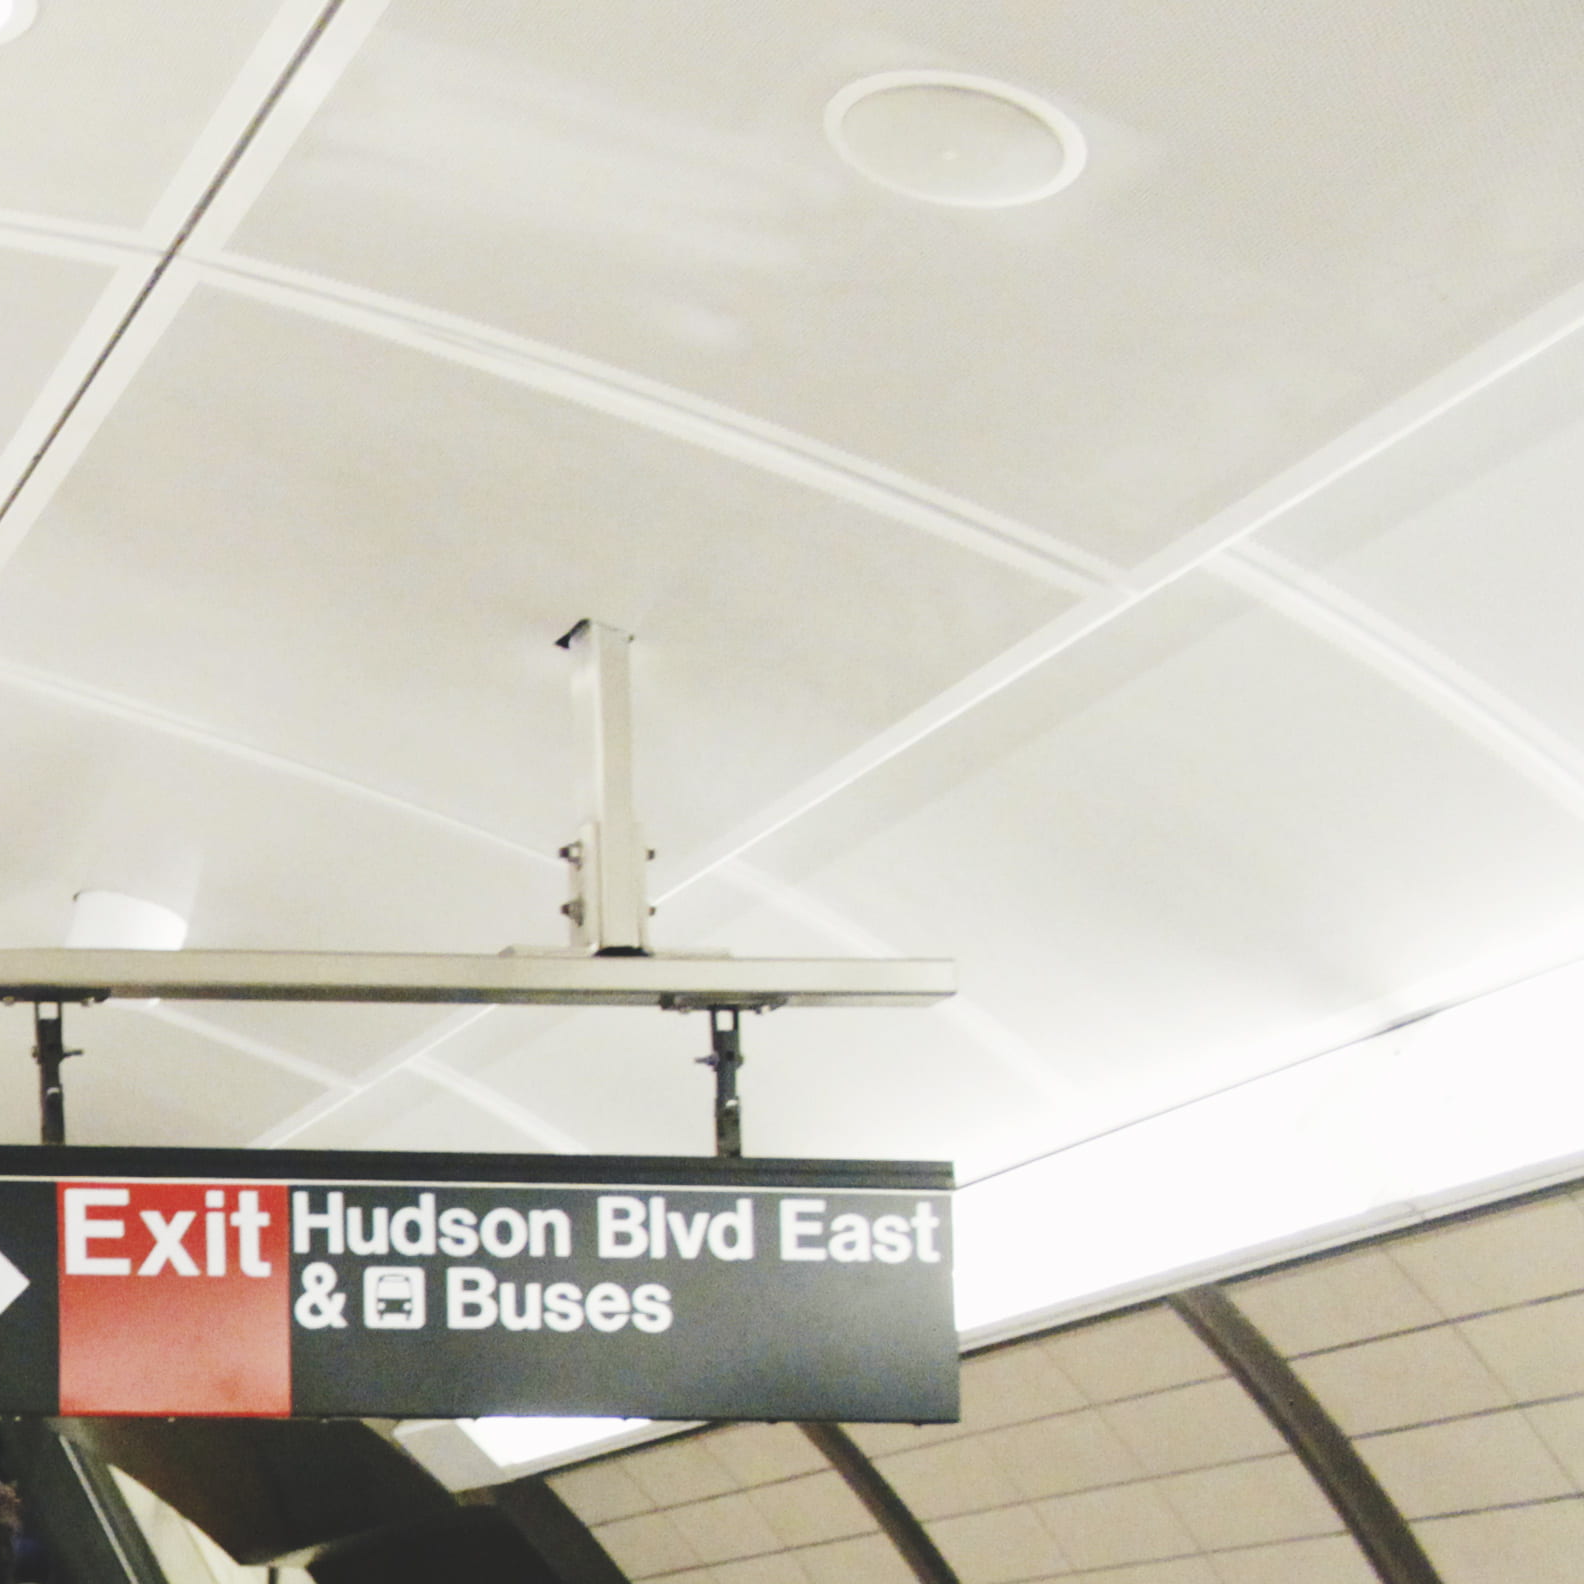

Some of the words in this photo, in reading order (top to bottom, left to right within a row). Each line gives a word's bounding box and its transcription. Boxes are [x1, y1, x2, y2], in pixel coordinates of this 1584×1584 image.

[64, 1188, 273, 1278] Exit
[292, 1190, 573, 1259] Hudson
[596, 1194, 758, 1263] Blvd
[777, 1198, 941, 1266] East
[293, 1261, 348, 1331] &
[445, 1266, 675, 1335] Buses
